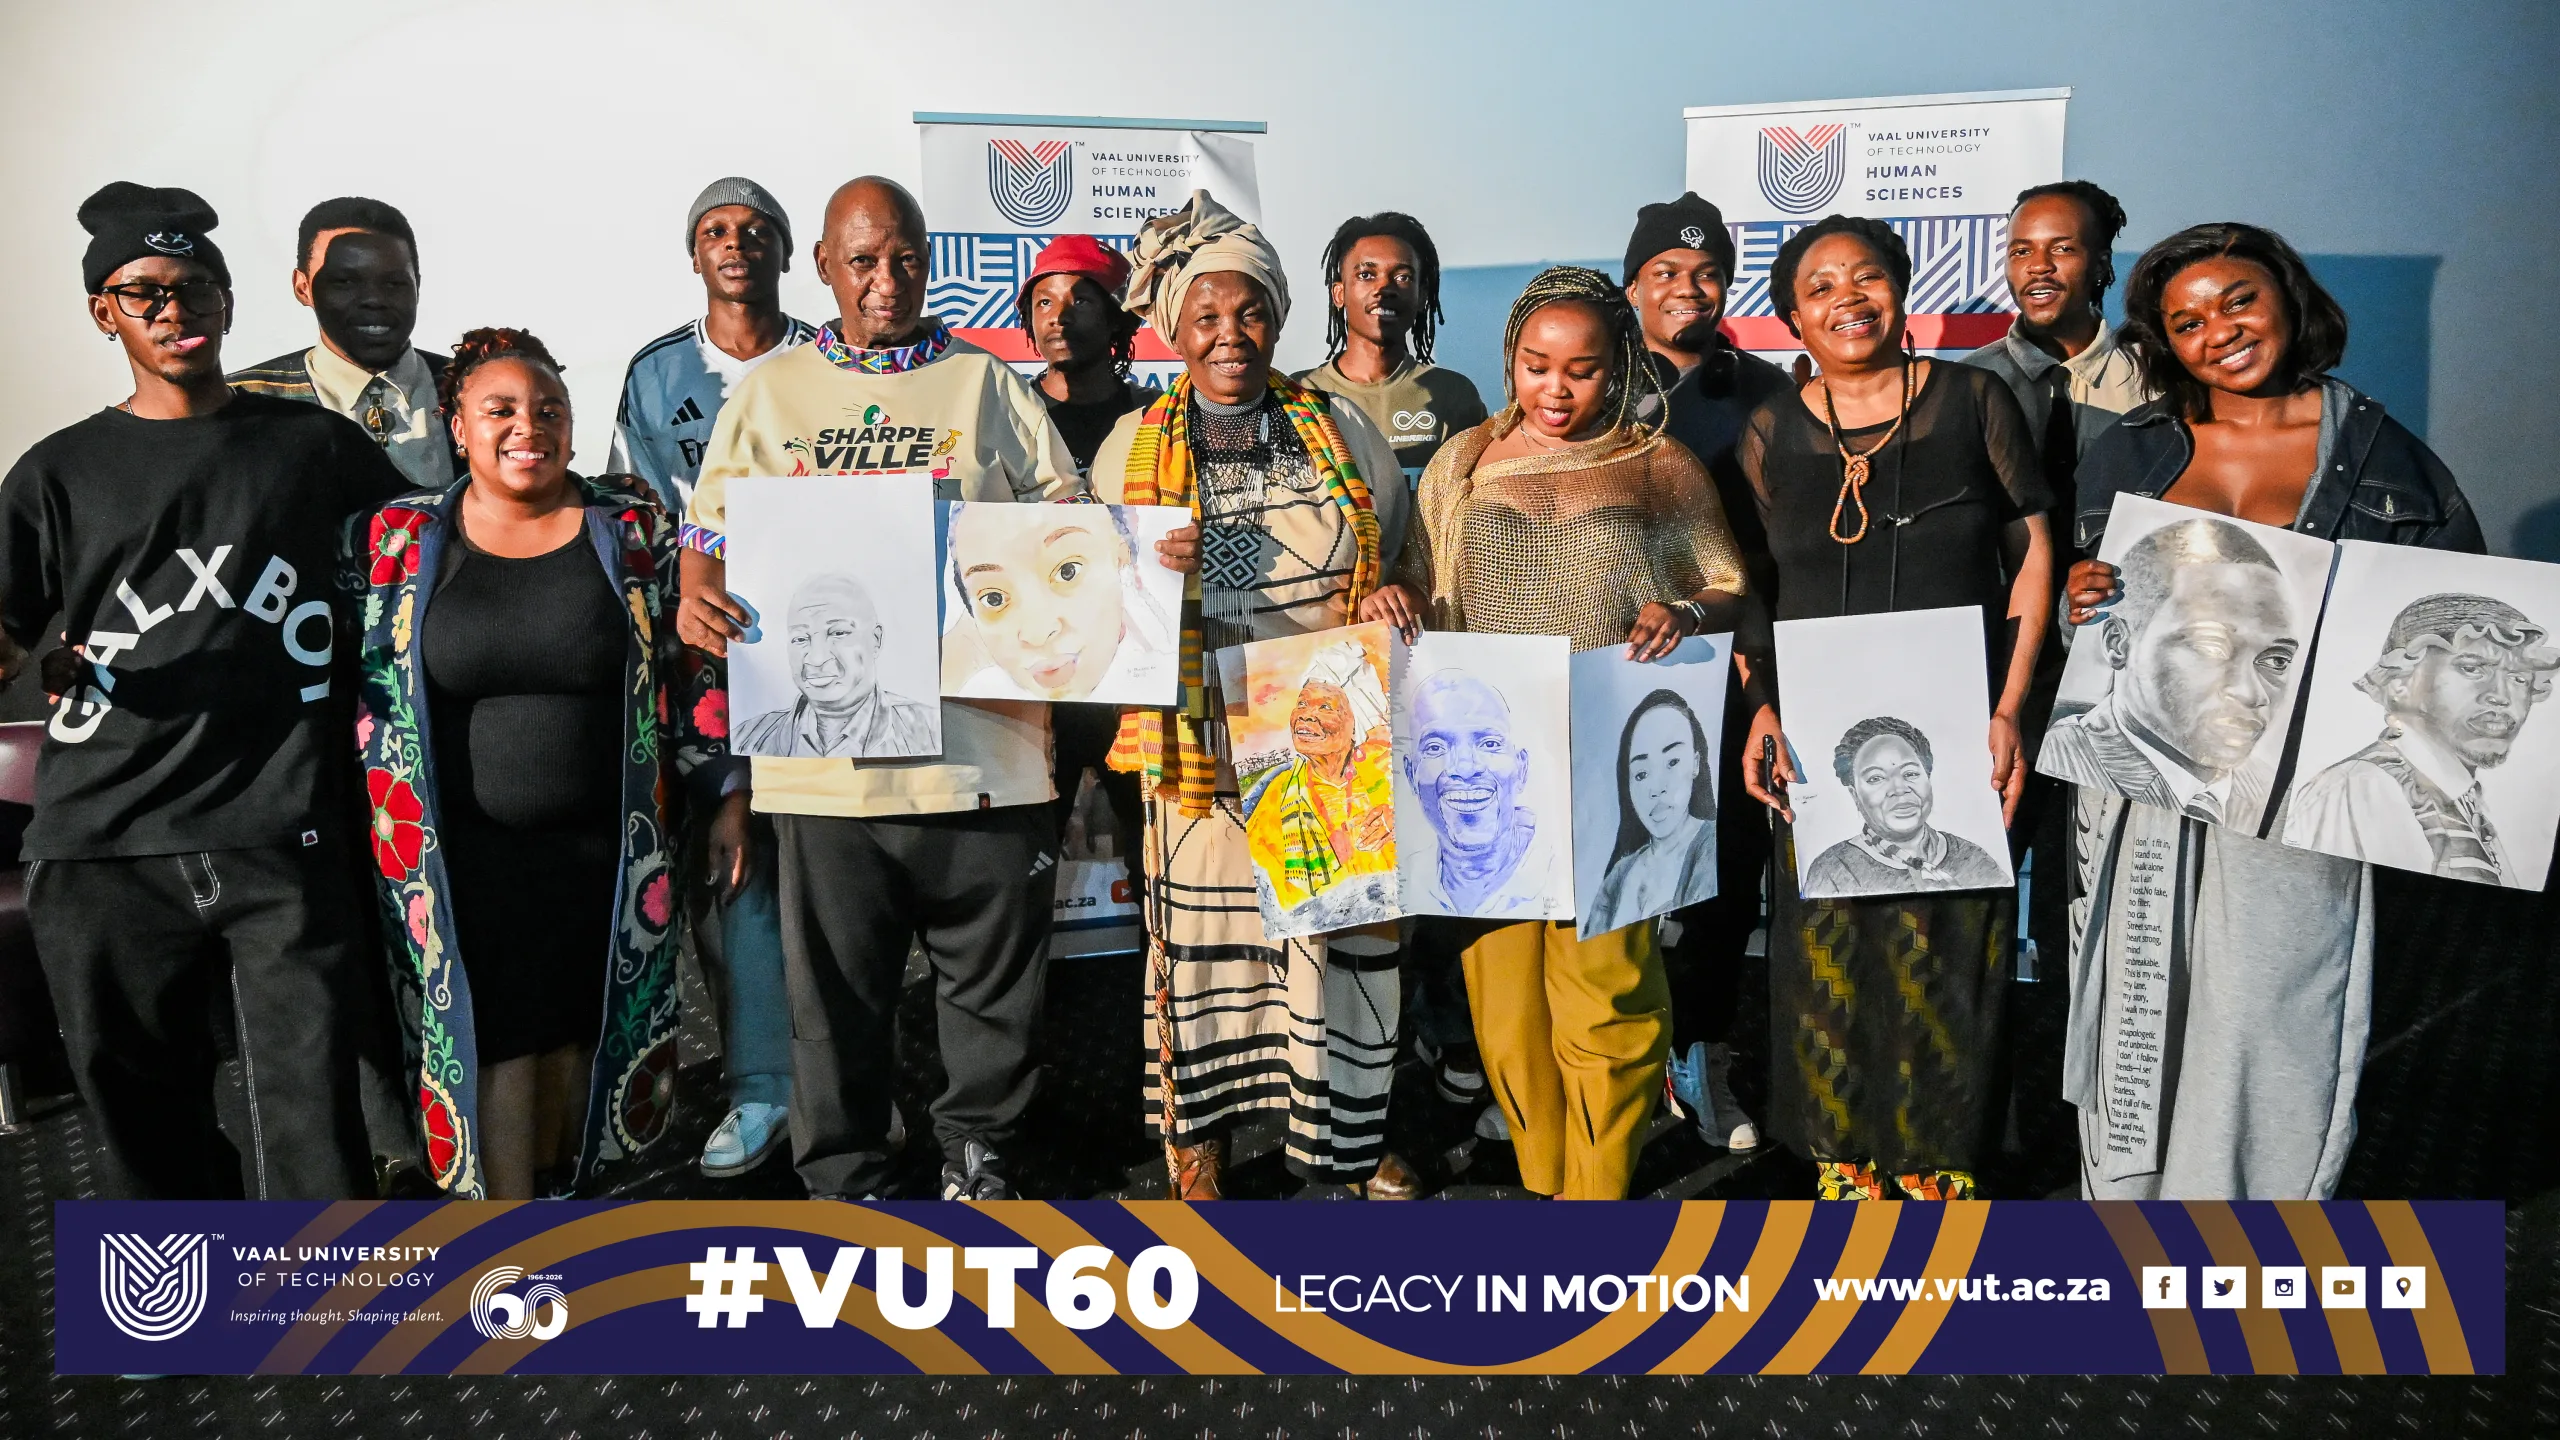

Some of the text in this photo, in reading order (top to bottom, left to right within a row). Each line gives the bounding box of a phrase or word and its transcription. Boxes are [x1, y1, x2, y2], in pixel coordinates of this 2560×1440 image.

[1868, 128, 1991, 142] VAAL UNIVERSITY
[1867, 143, 1982, 157] OF TECHNOLOGY
[1092, 152, 1200, 163] VAAL UNIVERSITY
[1092, 167, 1193, 178] OF TECHNOLOGY
[1866, 164, 1937, 179] HUMAN
[1092, 185, 1156, 198] HUMAN
[1866, 185, 1963, 201] SCIENCES
[816, 426, 935, 445] SHARPE
[814, 444, 933, 470] VILLE
[2135, 850, 2150, 859] stand
[2134, 862, 2147, 871] walk
[2148, 862, 2164, 872] alone
[2130, 873, 2139, 883] but
[2129, 899, 2136, 907] no
[2128, 910, 2136, 918] no
[2128, 921, 2143, 931] Street
[2127, 932, 2141, 943] heart
[2126, 946, 2140, 954] mind
[2124, 968, 2136, 978] This
[2142, 971, 2151, 981] my
[2124, 982, 2132, 991] my
[2122, 993, 2132, 1003] my
[2125, 1005, 2137, 1014] walk
[2139, 1007, 2148, 1016] my
[2119, 1029, 2156, 1040] unapologetic
[2118, 1040, 2128, 1048] and
[2140, 1052, 2158, 1063] follow
[2142, 1066, 2152, 1074] set
[2112, 1097, 2122, 1106] and
[2124, 1098, 2132, 1107] full
[2134, 1100, 2140, 1108] of
[2111, 1107, 2122, 1118] This
[2121, 1122, 2132, 1130] and
[2108, 1132, 2148, 1147] owning every
